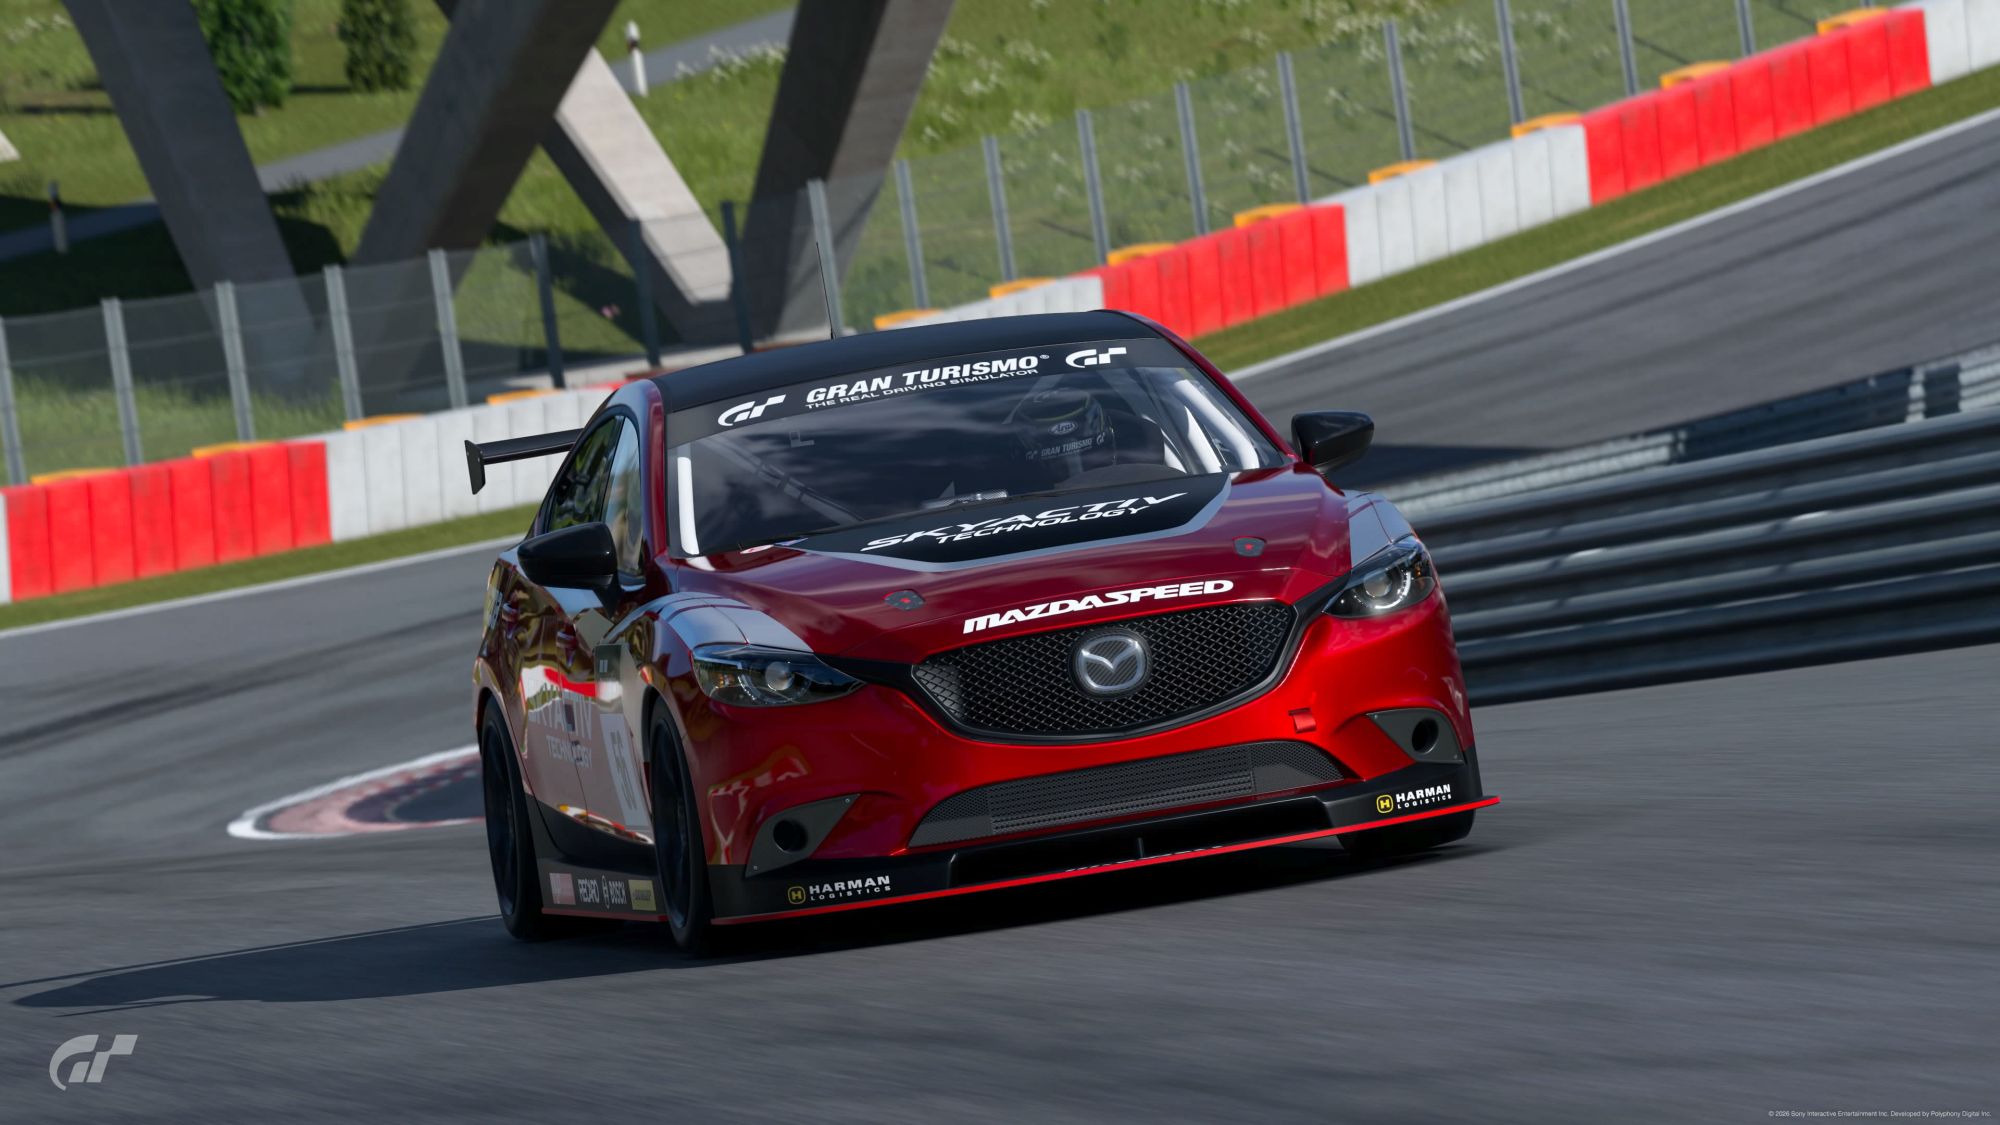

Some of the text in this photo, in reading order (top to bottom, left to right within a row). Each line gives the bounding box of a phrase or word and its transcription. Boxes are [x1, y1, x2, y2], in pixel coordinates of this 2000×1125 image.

[806, 368, 1039, 410] THE REAL DRIVING SIMULATOR
[806, 375, 893, 404] GRAN
[859, 491, 1189, 552] SKYACTIV
[936, 505, 1150, 545] TECHNOLOGY
[963, 579, 1234, 635] MAZDASPEED
[1395, 783, 1451, 803] HARMAN
[1397, 793, 1452, 810] LOGISTICS
[809, 875, 890, 895] HARMAN
[810, 885, 892, 901] LOGISTICS
